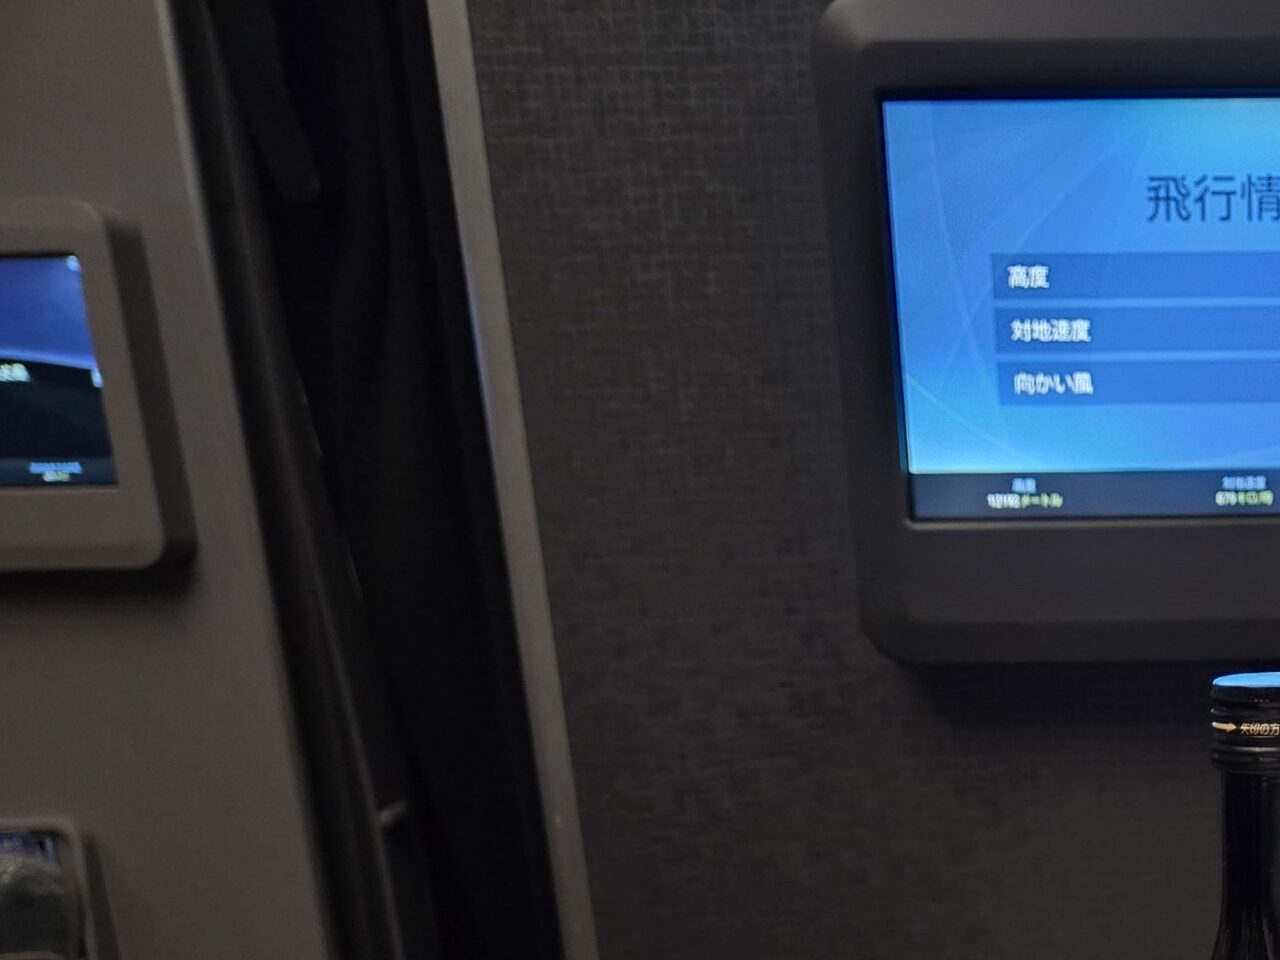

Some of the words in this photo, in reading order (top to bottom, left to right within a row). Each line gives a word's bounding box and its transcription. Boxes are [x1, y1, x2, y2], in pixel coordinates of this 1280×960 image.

[1007, 265, 1050, 289] 高度
[1010, 319, 1092, 343] 対地速度
[1013, 371, 1094, 396] 向かい風
